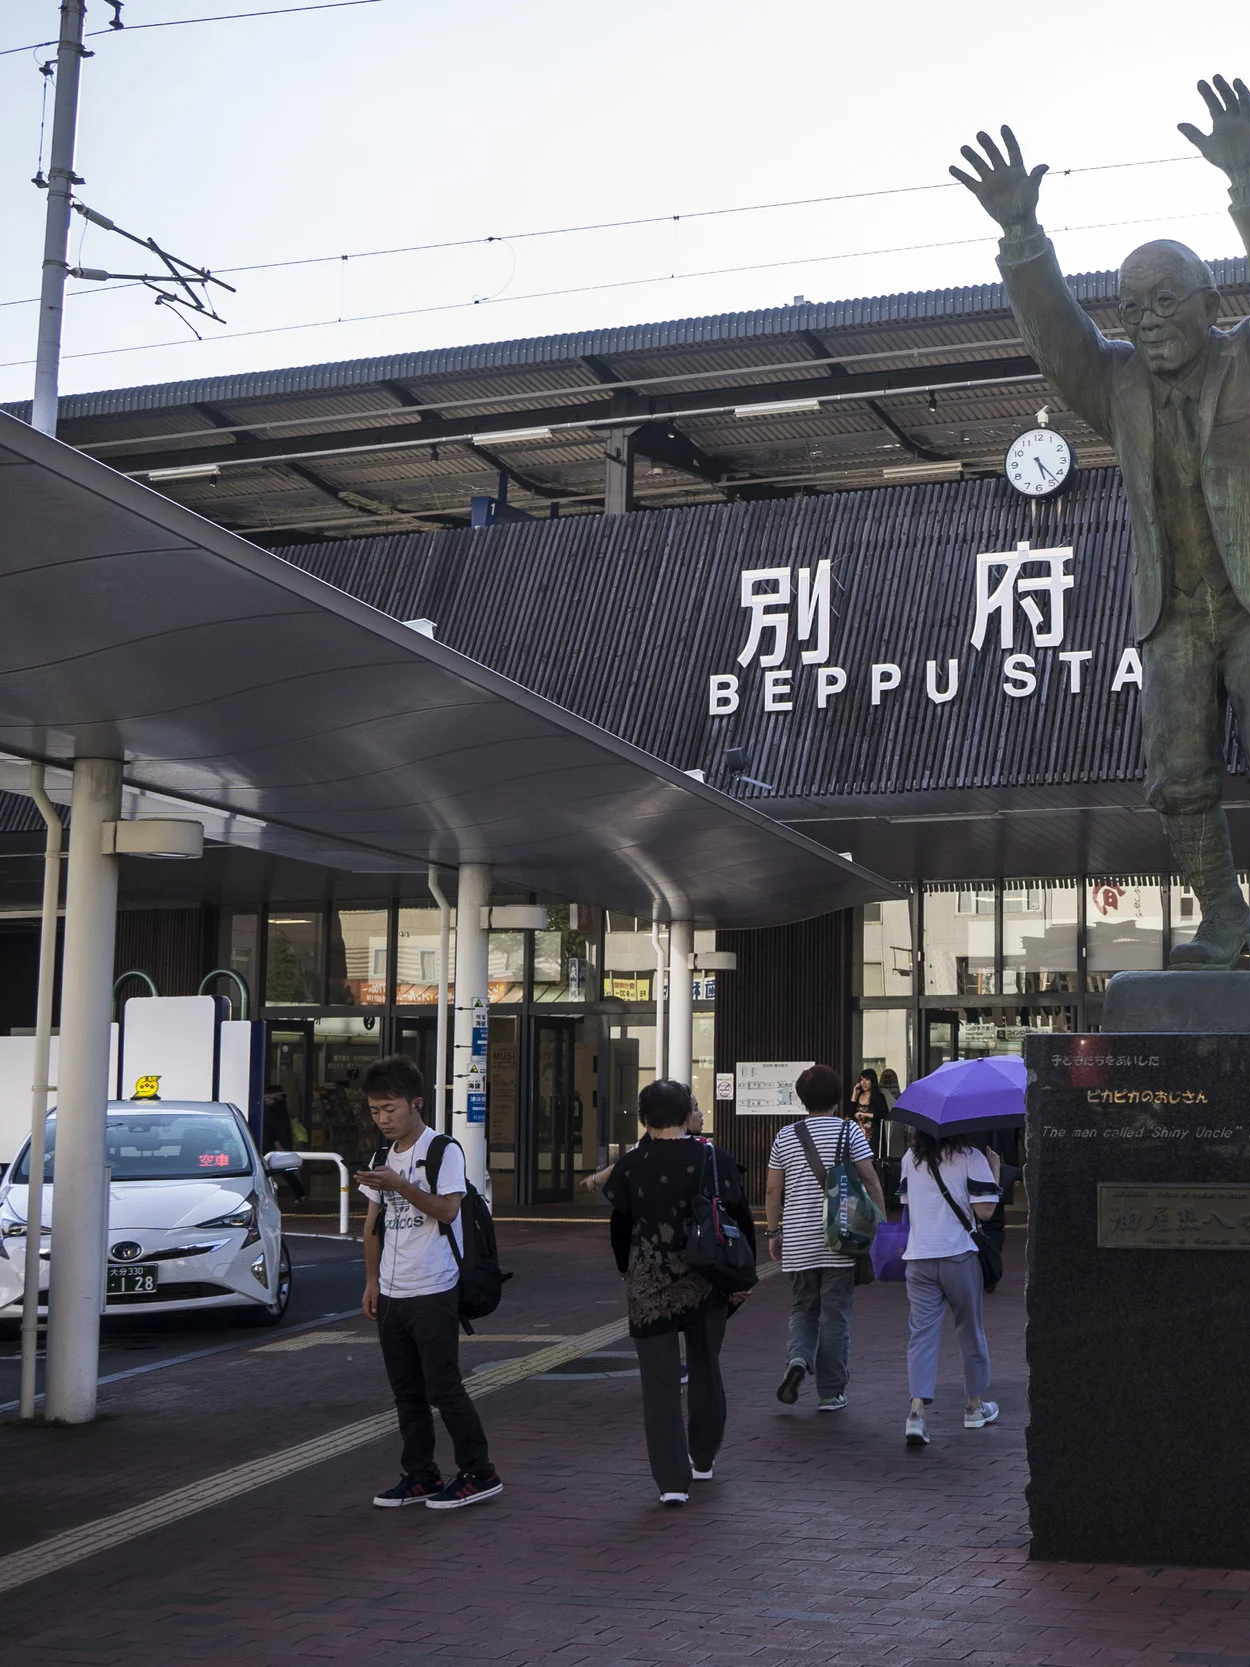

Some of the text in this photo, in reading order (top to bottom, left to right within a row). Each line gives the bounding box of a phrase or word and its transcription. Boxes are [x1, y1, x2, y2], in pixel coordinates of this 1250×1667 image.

[1034, 434, 1044, 442] 12
[1060, 457, 1067, 465] 3
[1035, 484, 1043, 492] 6
[1048, 479, 1056, 487] 5
[709, 658, 960, 717] BEPPU
[1051, 1054, 1160, 1067] 子どもたちをあいした
[1086, 1089, 1208, 1104] ピカピカのおじさん
[1042, 1125, 1067, 1138] The
[1072, 1128, 1098, 1138] man
[1103, 1127, 1145, 1138] called
[198, 1153, 229, 1167] 空車
